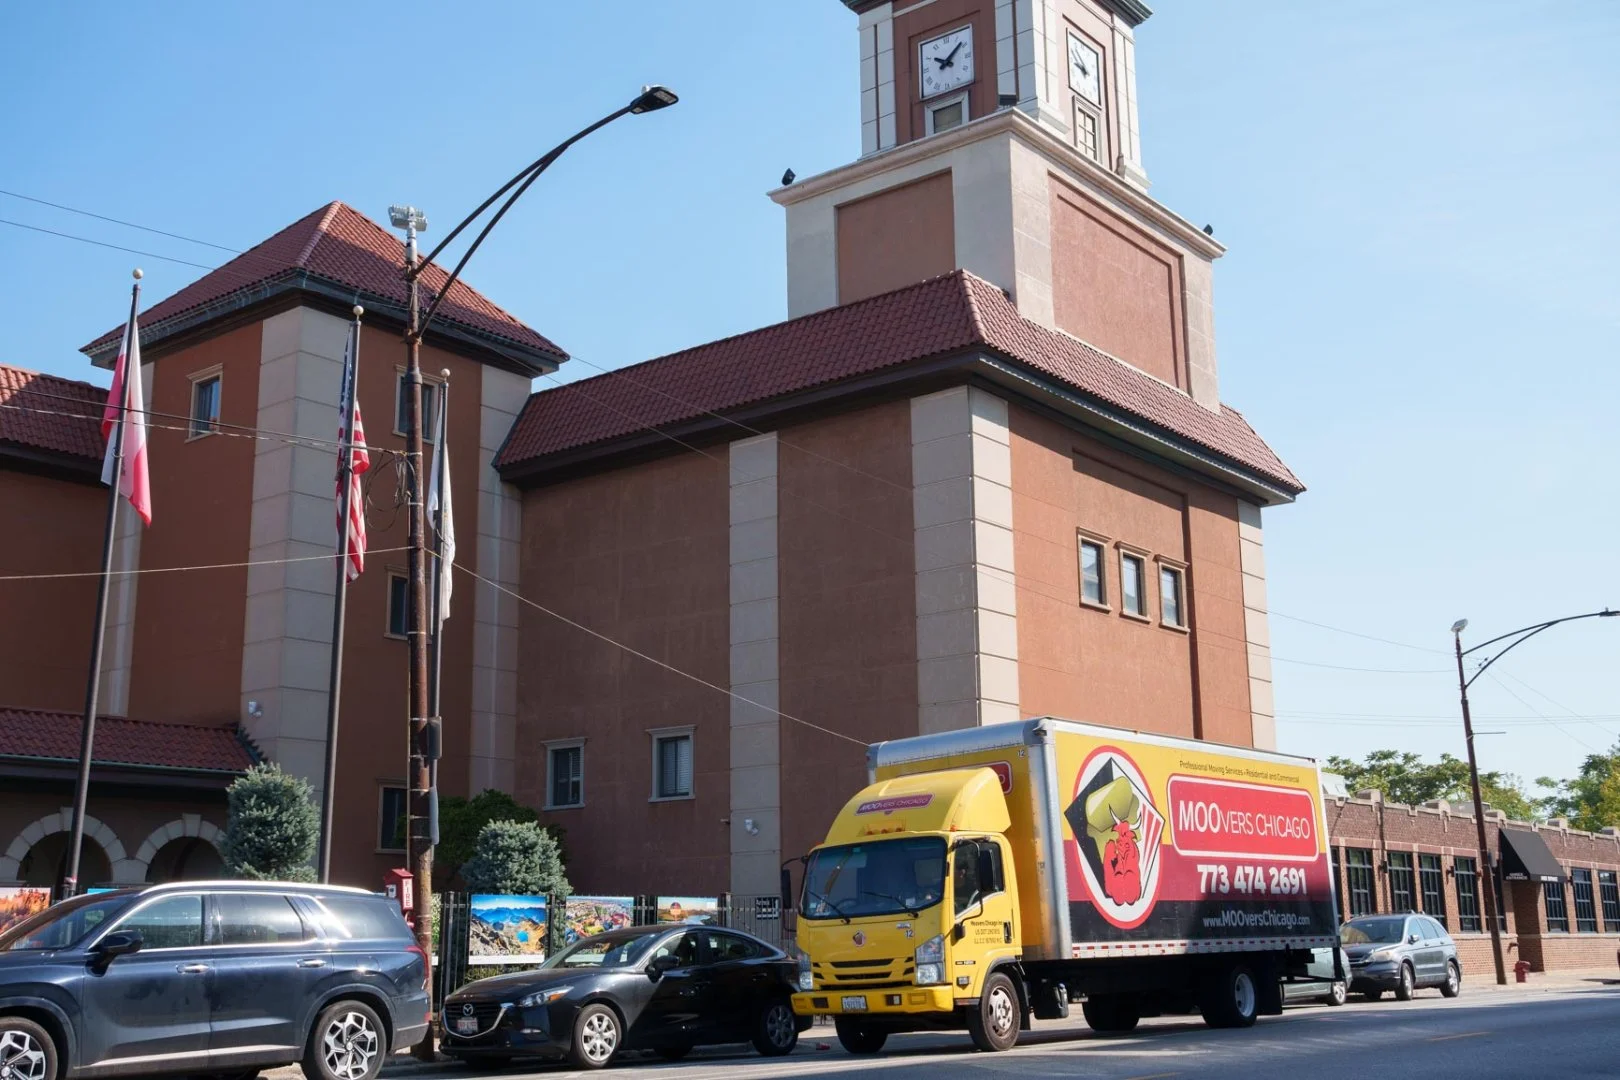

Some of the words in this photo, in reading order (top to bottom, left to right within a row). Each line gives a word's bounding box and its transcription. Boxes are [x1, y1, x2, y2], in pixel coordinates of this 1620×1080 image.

[1179, 760, 1208, 772] Professional
[1208, 763, 1225, 776] Moving
[1225, 766, 1243, 777] Services
[1178, 799, 1254, 834] MOOVERS
[1255, 813, 1310, 840] CHICAGO
[1197, 864, 1230, 894] 773
[1233, 865, 1266, 894] 474
[1268, 867, 1307, 895] 2691
[1203, 910, 1310, 929] www.MOOversChicago.com
[905, 930, 914, 938] 12
